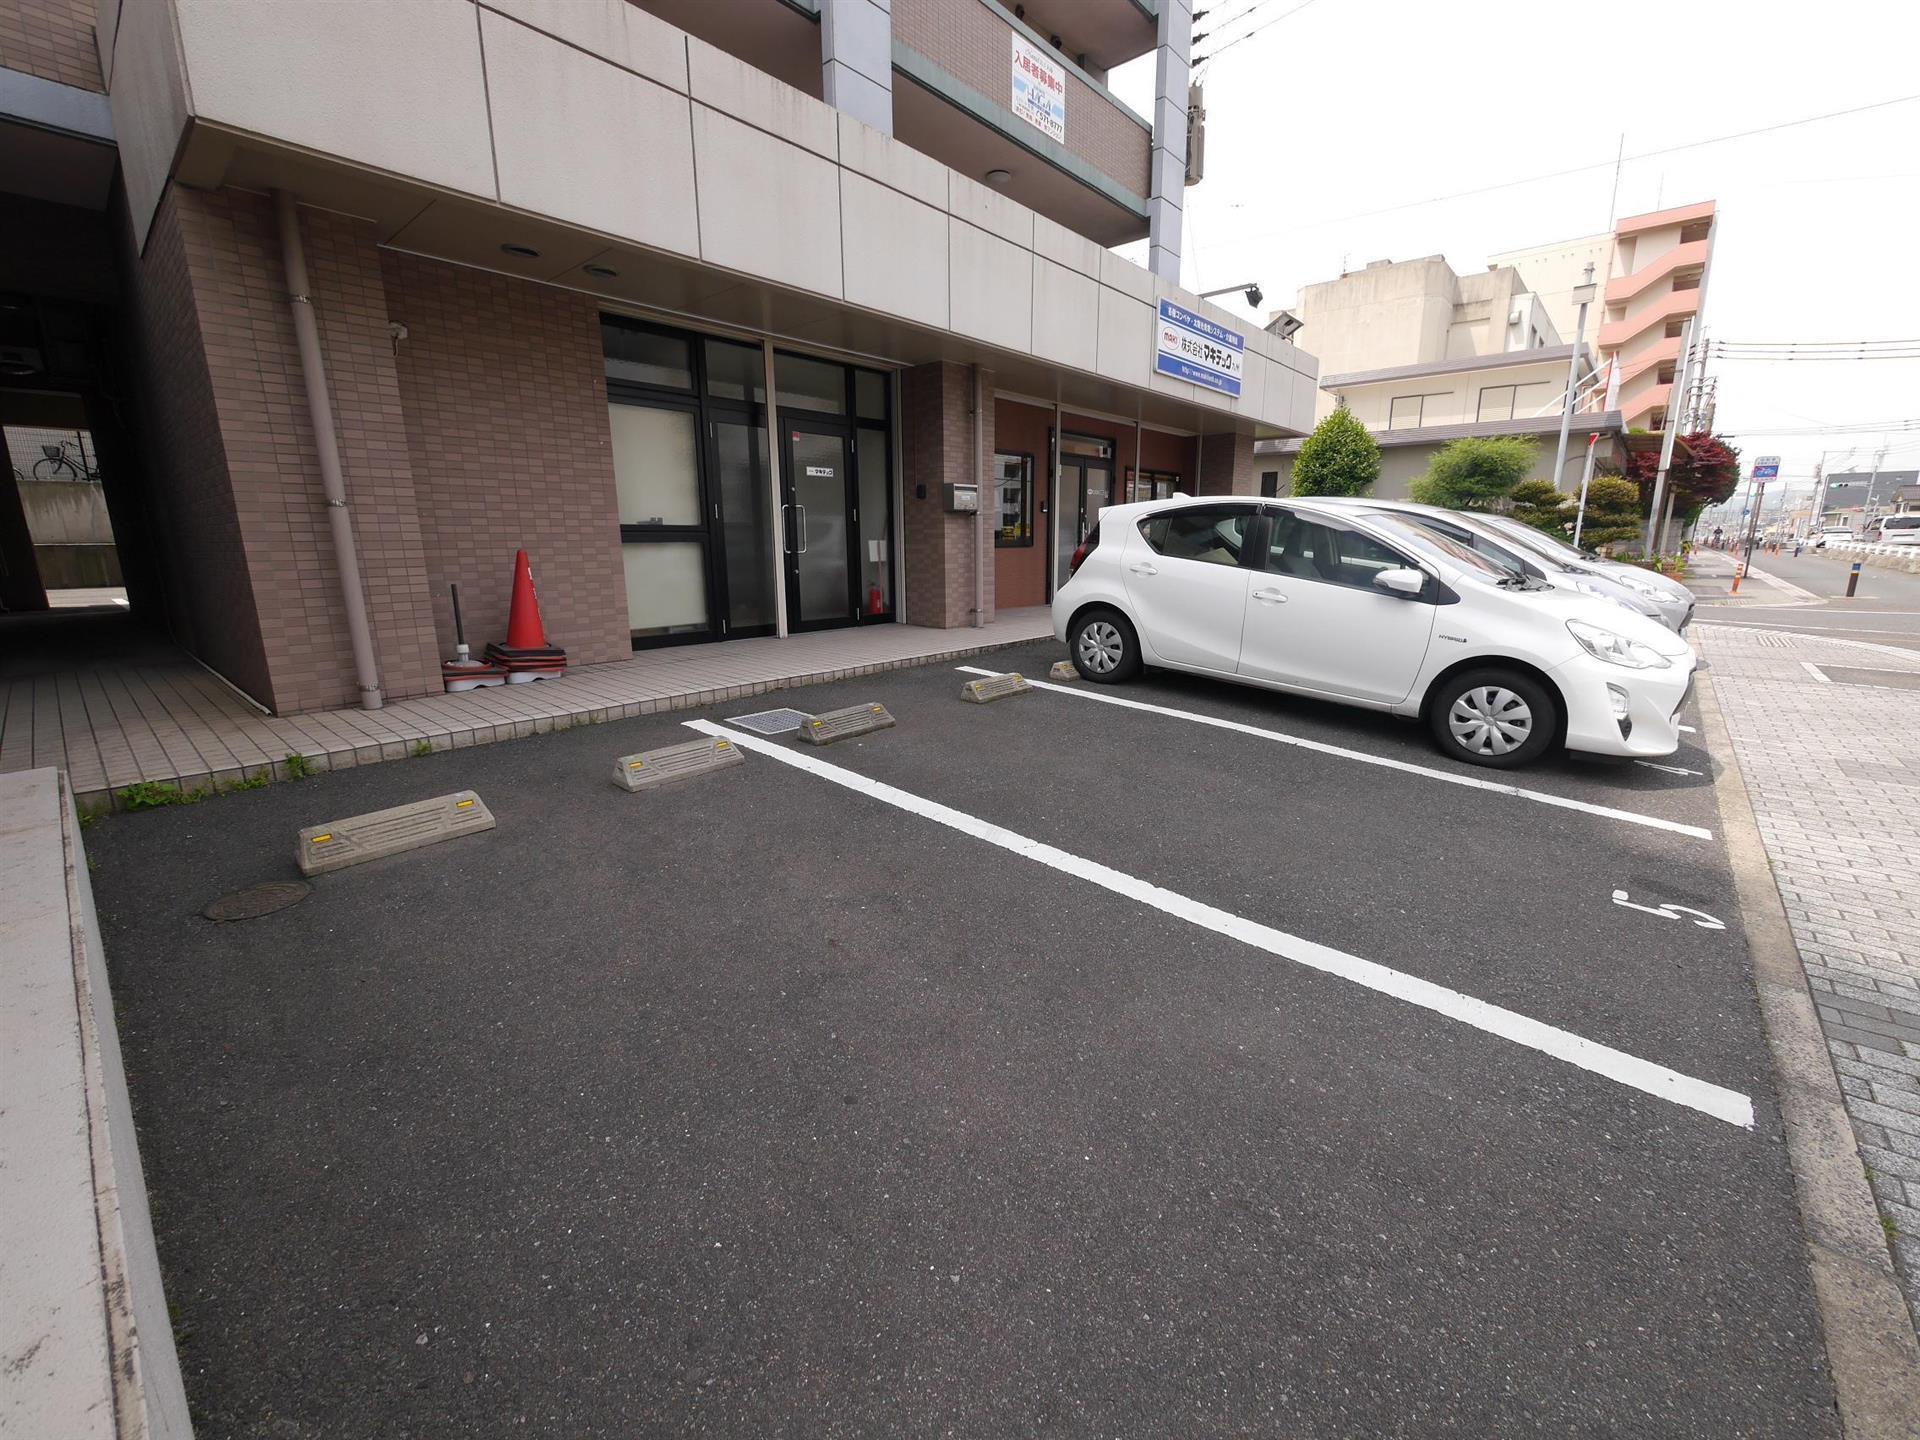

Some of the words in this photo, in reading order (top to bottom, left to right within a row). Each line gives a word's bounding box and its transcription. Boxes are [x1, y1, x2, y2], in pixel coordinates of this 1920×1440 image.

[1015, 50, 1063, 95] 入居者募集中
